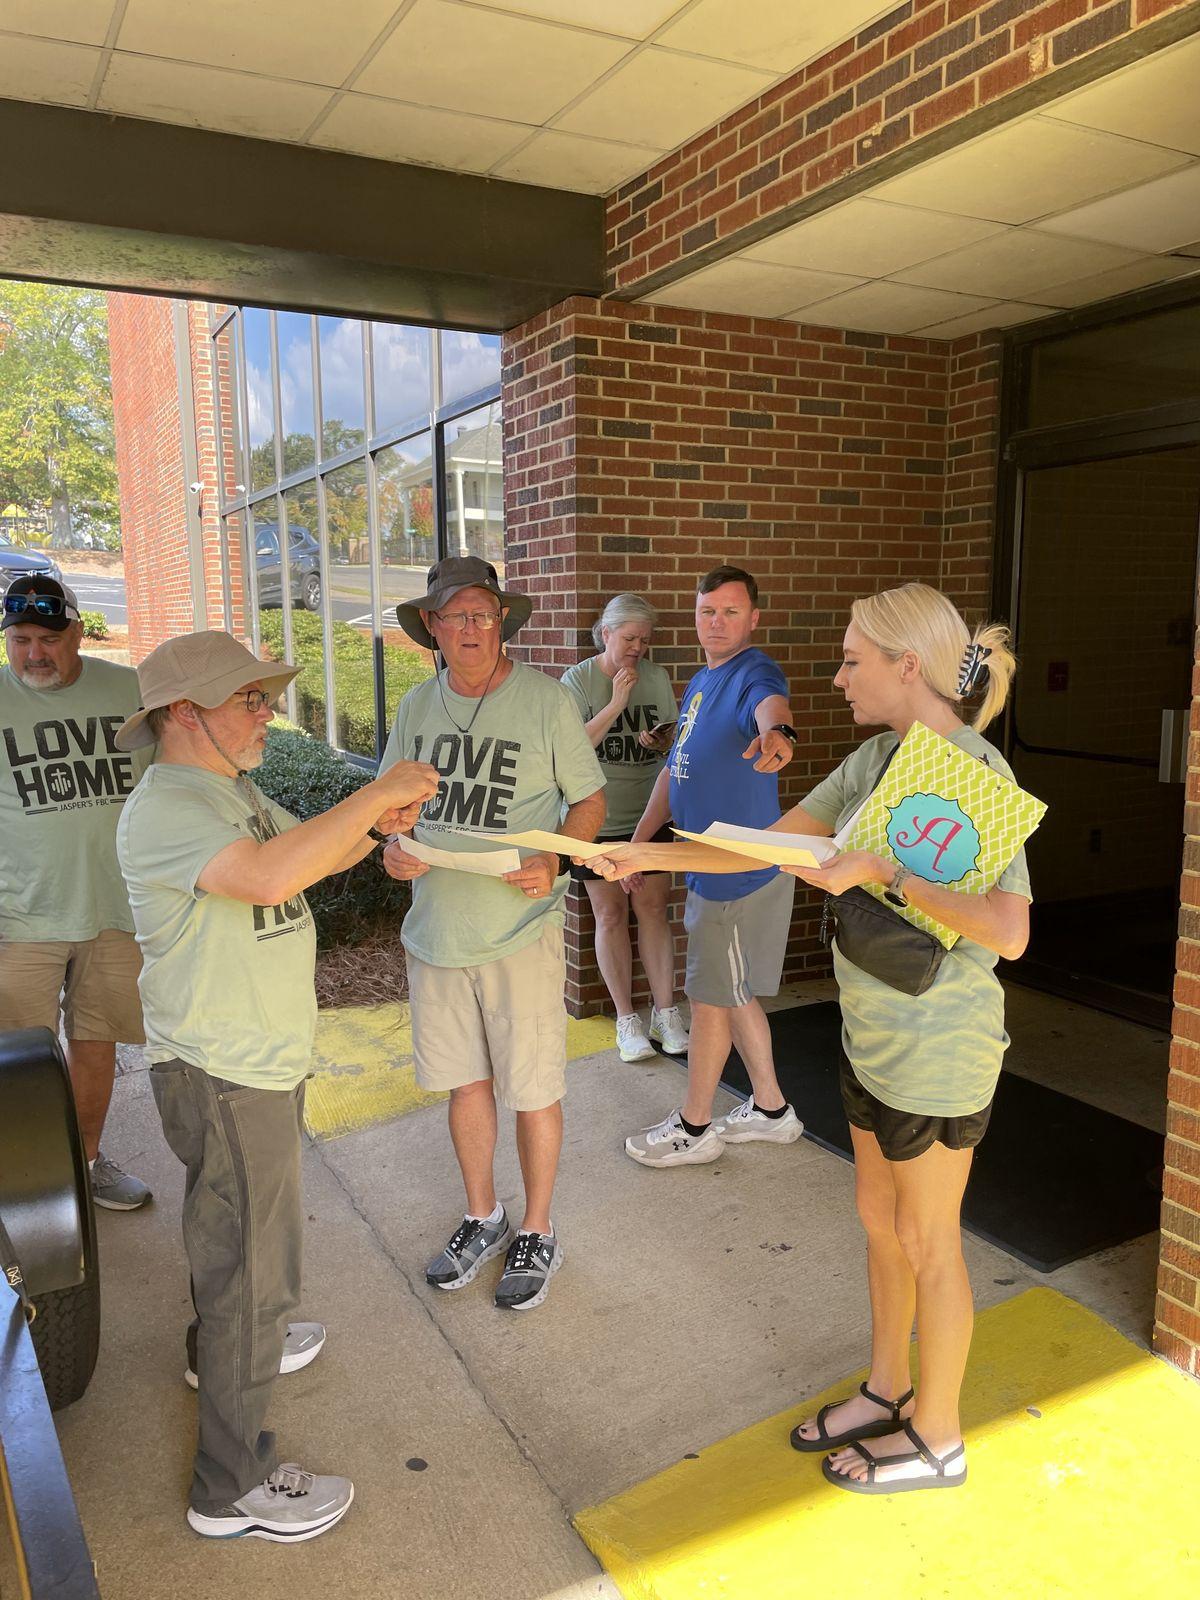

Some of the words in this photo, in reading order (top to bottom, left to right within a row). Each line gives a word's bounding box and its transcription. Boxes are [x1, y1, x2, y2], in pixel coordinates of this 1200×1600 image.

[2, 716, 132, 767] LOVE
[12, 757, 136, 808] HOME
[59, 800, 94, 812] JASPER'S
[95, 798, 110, 807] FBC
[419, 780, 515, 829] OME
[895, 815, 963, 874] A
